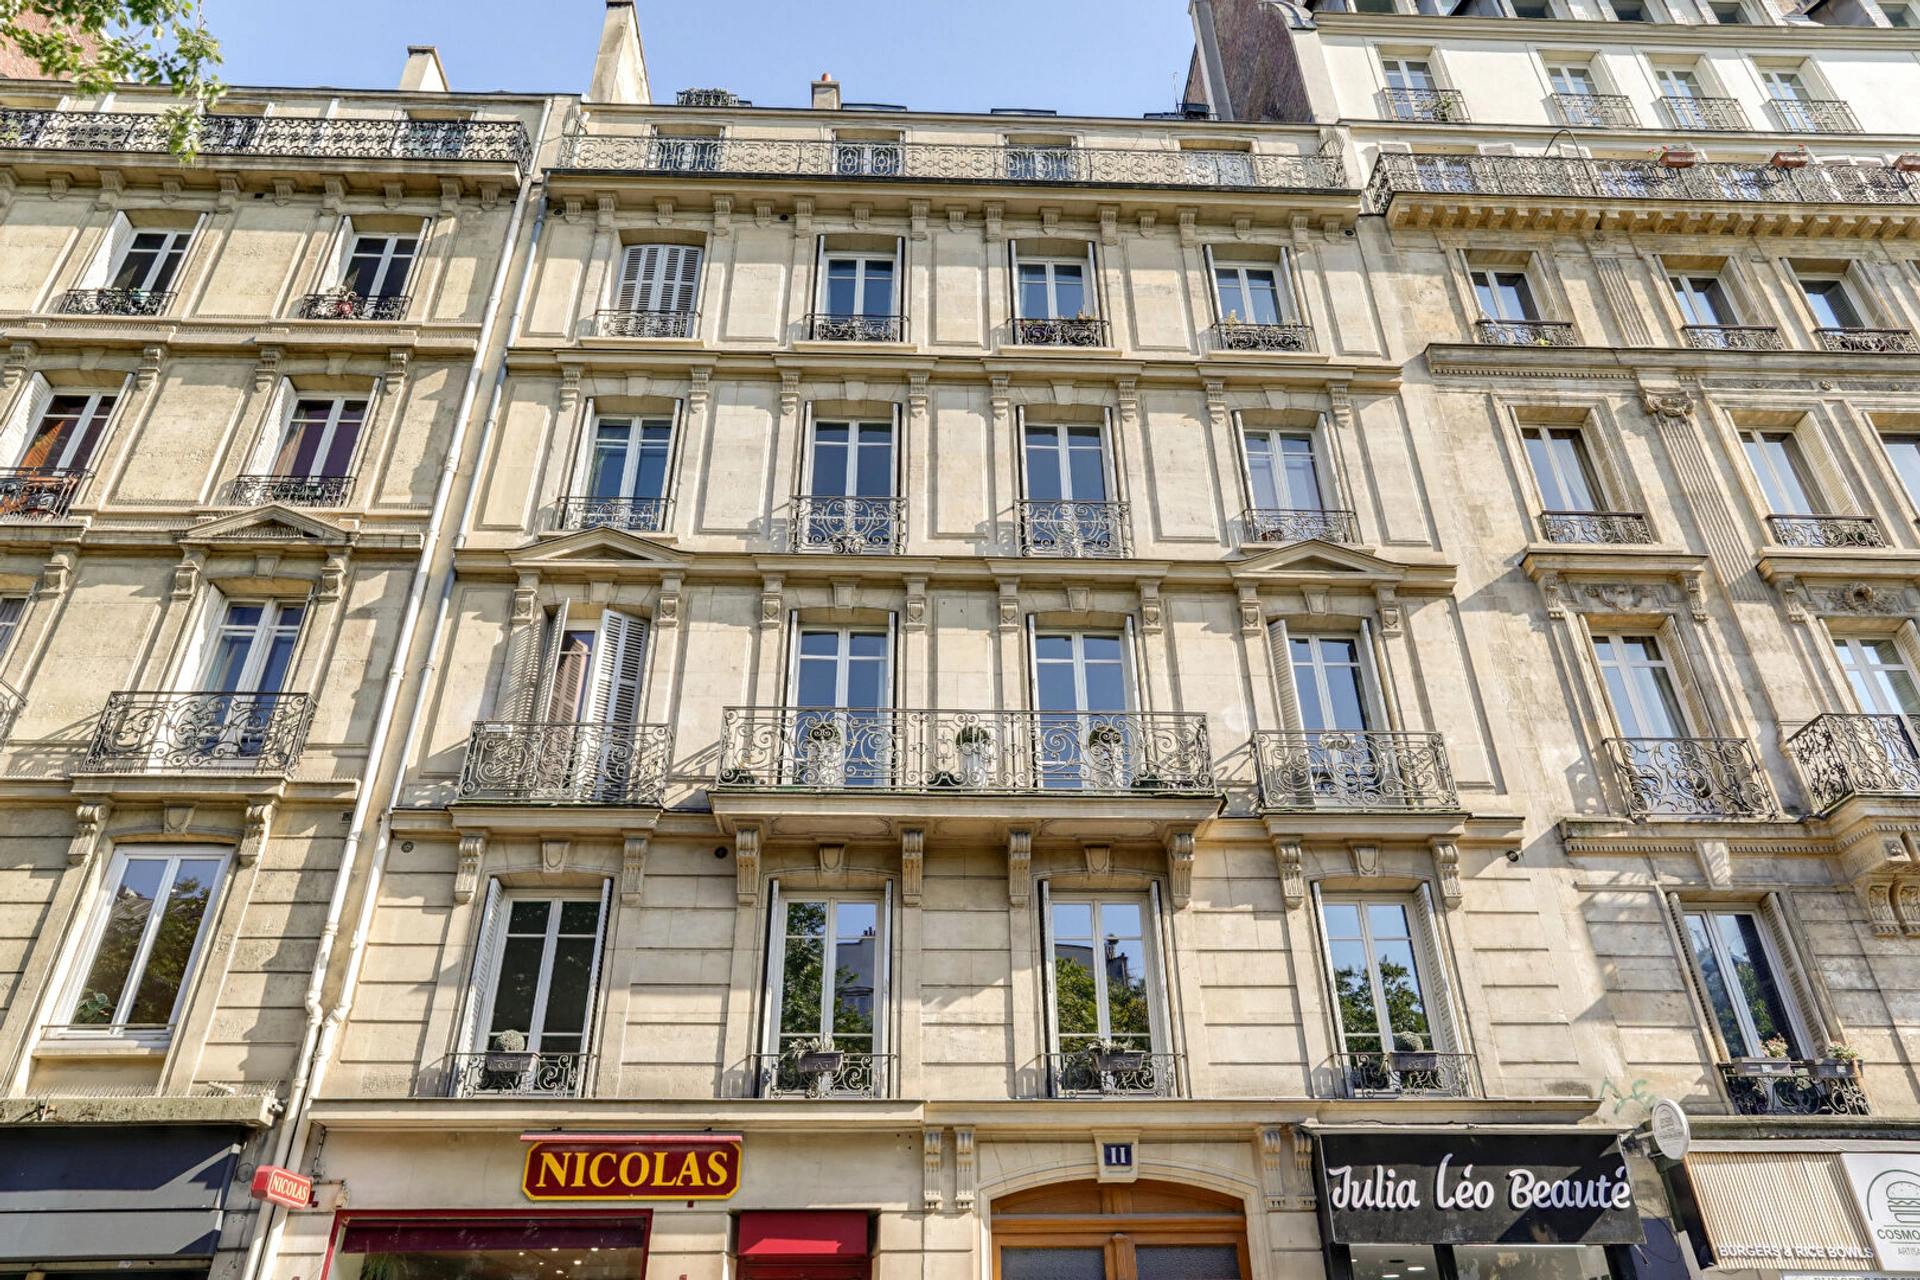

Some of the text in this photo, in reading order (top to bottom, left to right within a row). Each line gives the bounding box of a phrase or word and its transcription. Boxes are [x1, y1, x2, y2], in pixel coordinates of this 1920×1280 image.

[1110, 1147, 1126, 1164] 11
[535, 1151, 728, 1187] NICOLAS
[1328, 1153, 1631, 1209] Julia Léo Beauté
[270, 1175, 308, 1201] NICOLAS
[1719, 1245, 1874, 1259] BURGERS & RICE BOWLS
